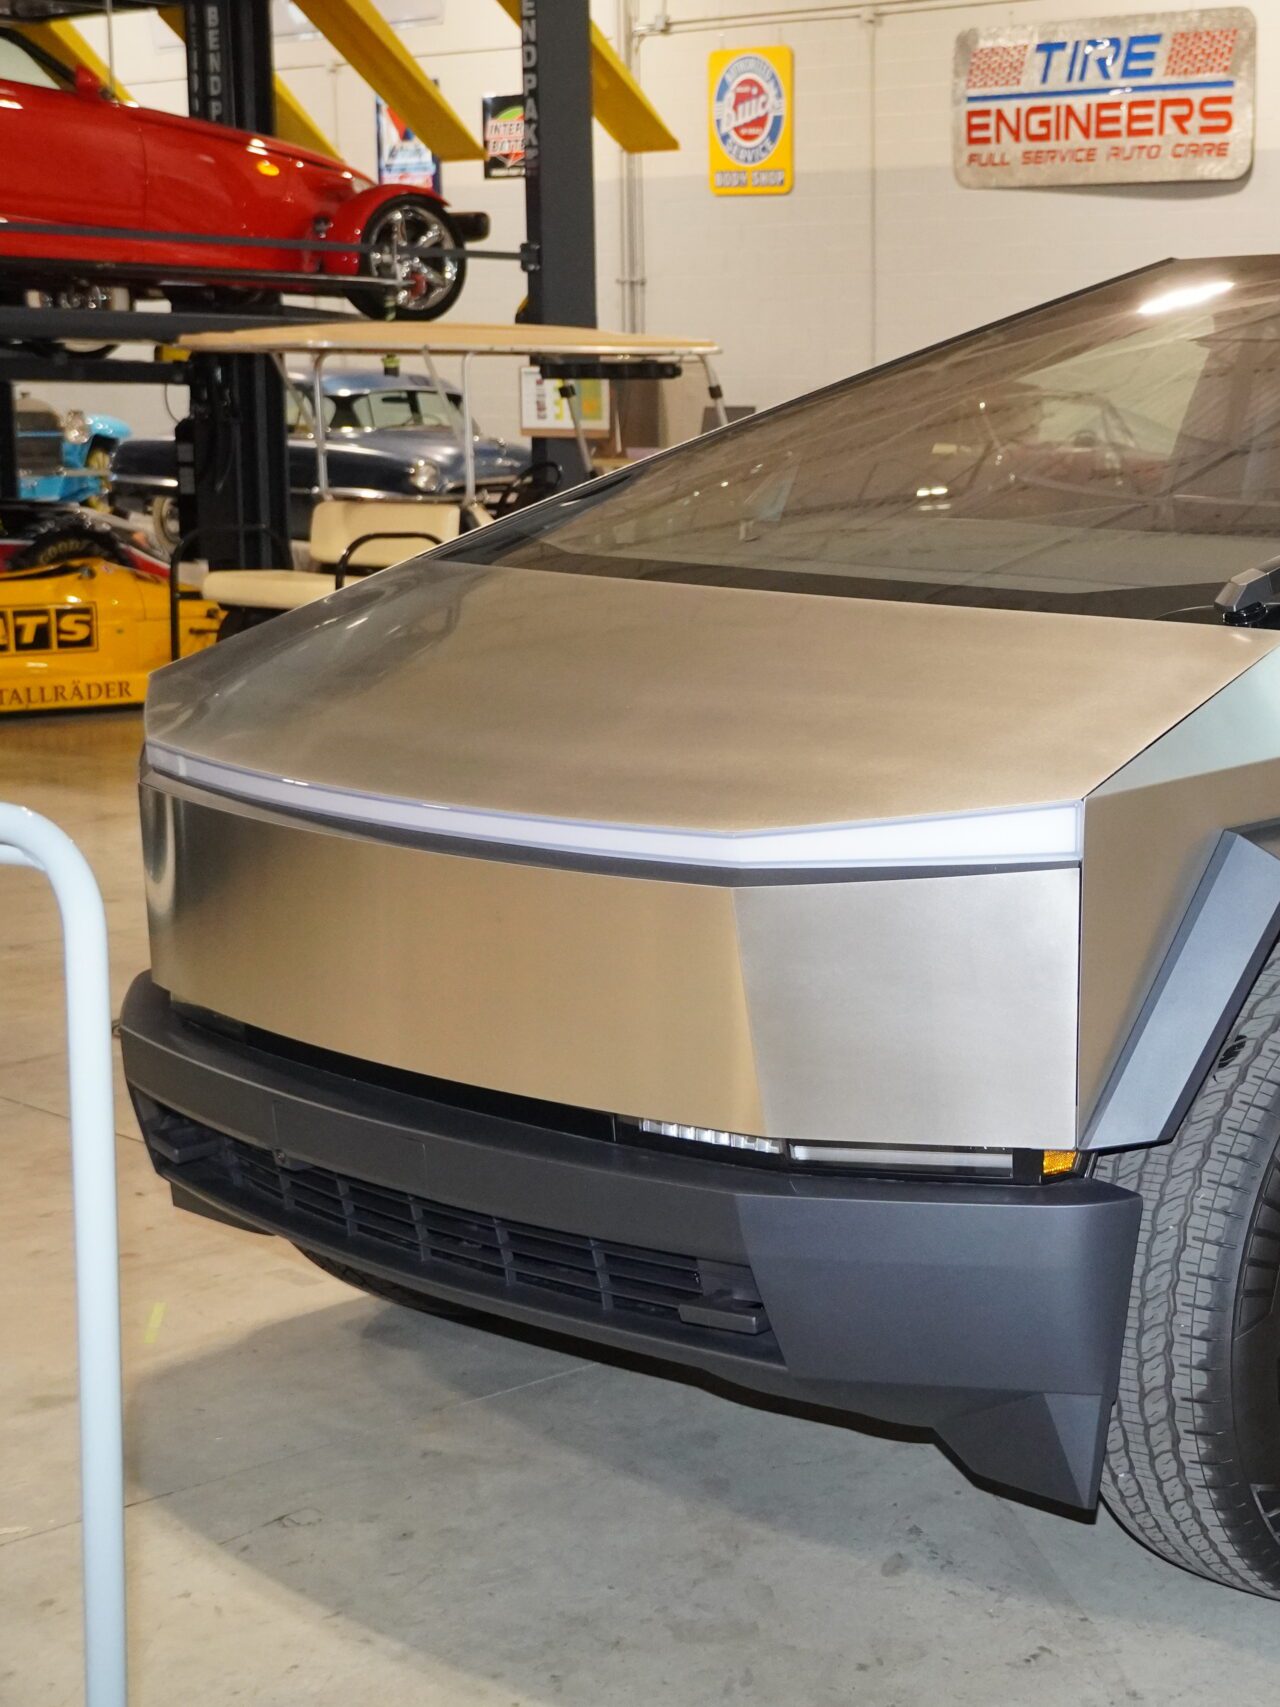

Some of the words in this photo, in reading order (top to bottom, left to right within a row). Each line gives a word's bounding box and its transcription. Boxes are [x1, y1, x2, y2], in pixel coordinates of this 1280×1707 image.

[1035, 33, 1164, 84] TIRE
[966, 95, 1234, 146] ENGINEERS
[726, 137, 776, 163] SERVICE
[967, 152, 1011, 167] FULL
[1021, 147, 1098, 165] SERVICE
[1106, 144, 1162, 161] AUTO
[1171, 142, 1231, 159] CARE
[715, 170, 748, 187] BODY
[751, 169, 786, 187] SHOP
[0, 613, 92, 645] TS
